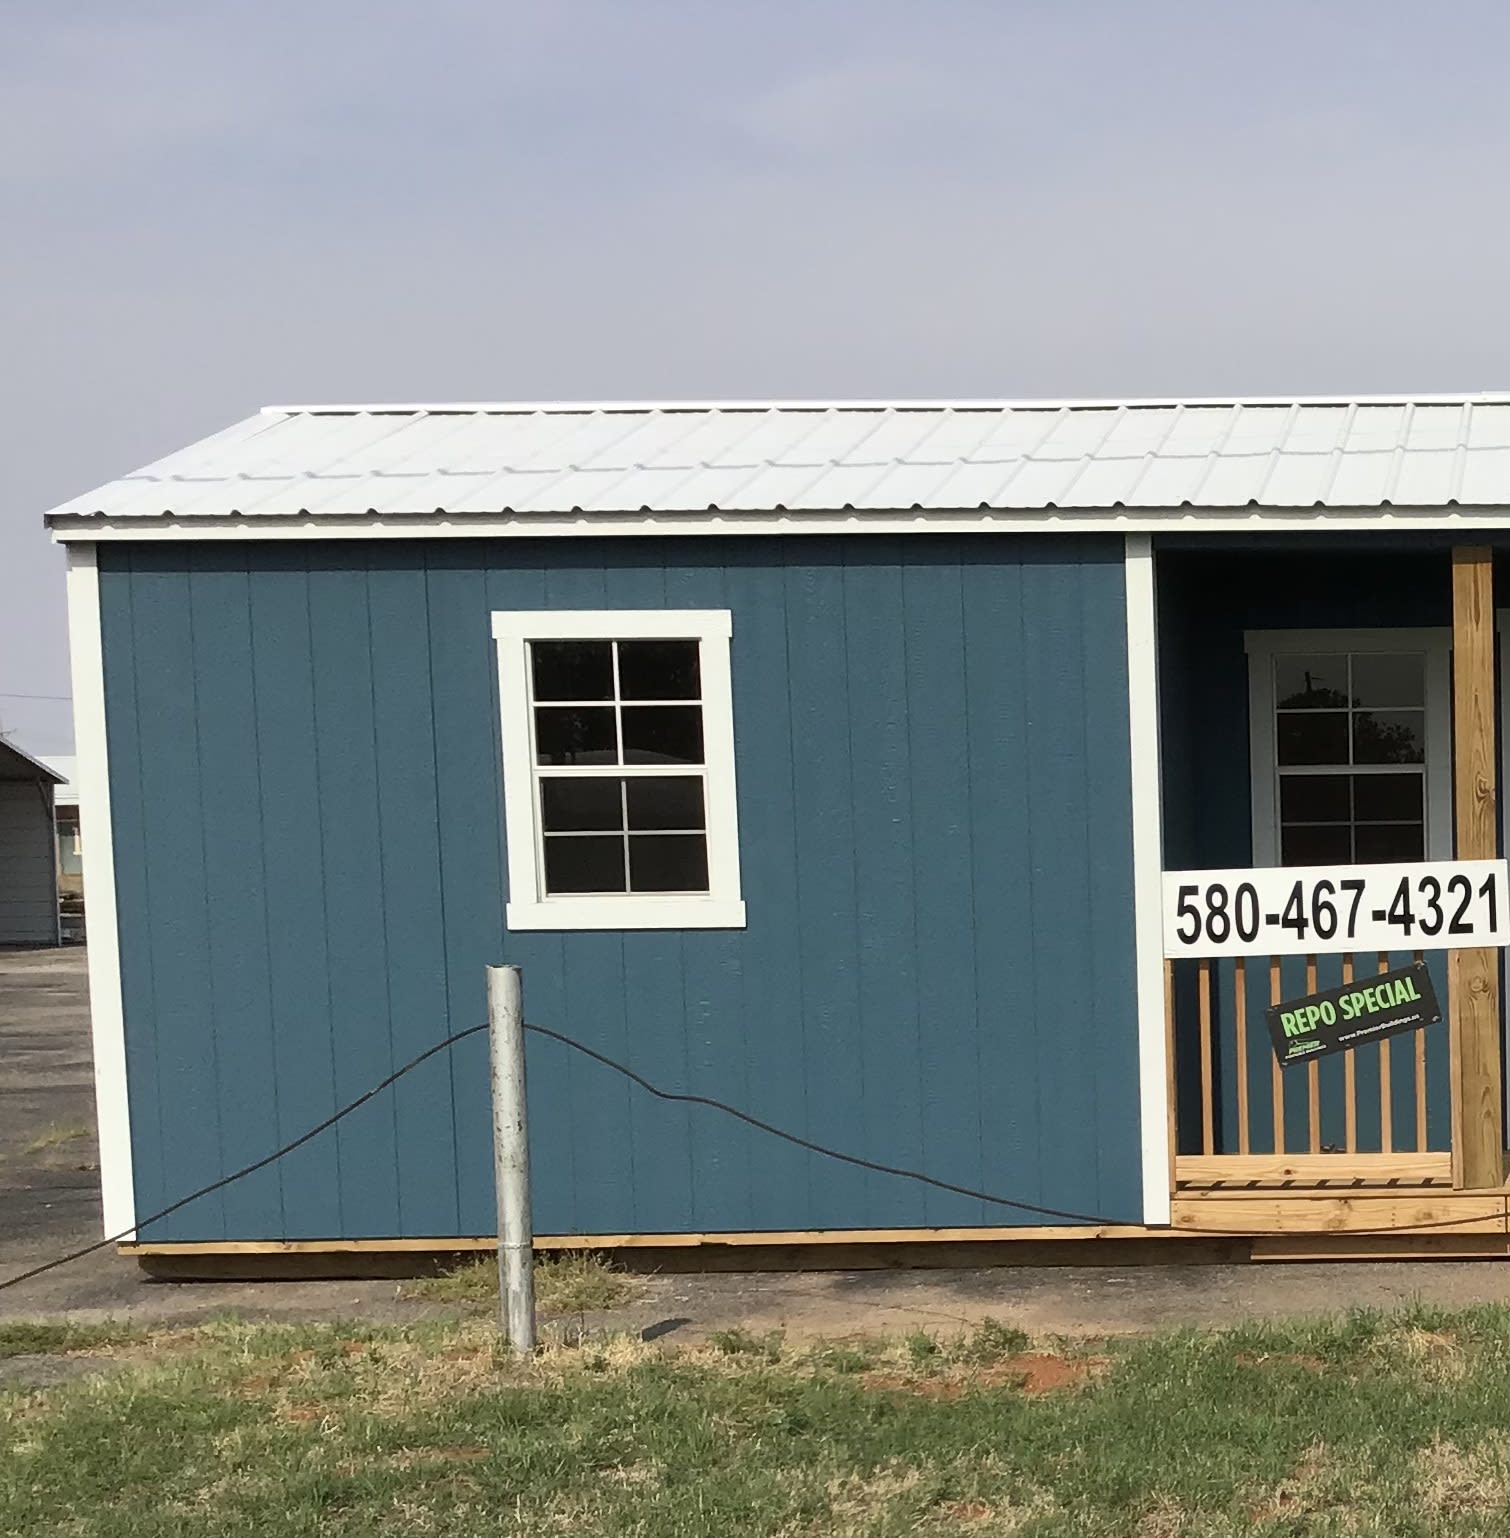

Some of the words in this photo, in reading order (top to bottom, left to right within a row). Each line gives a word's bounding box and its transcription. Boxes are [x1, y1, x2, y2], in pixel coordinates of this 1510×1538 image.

[1176, 873, 1498, 945] 580-467-4321
[1280, 1000, 1337, 1038] REPO
[1338, 976, 1422, 1020] SPECIAL
